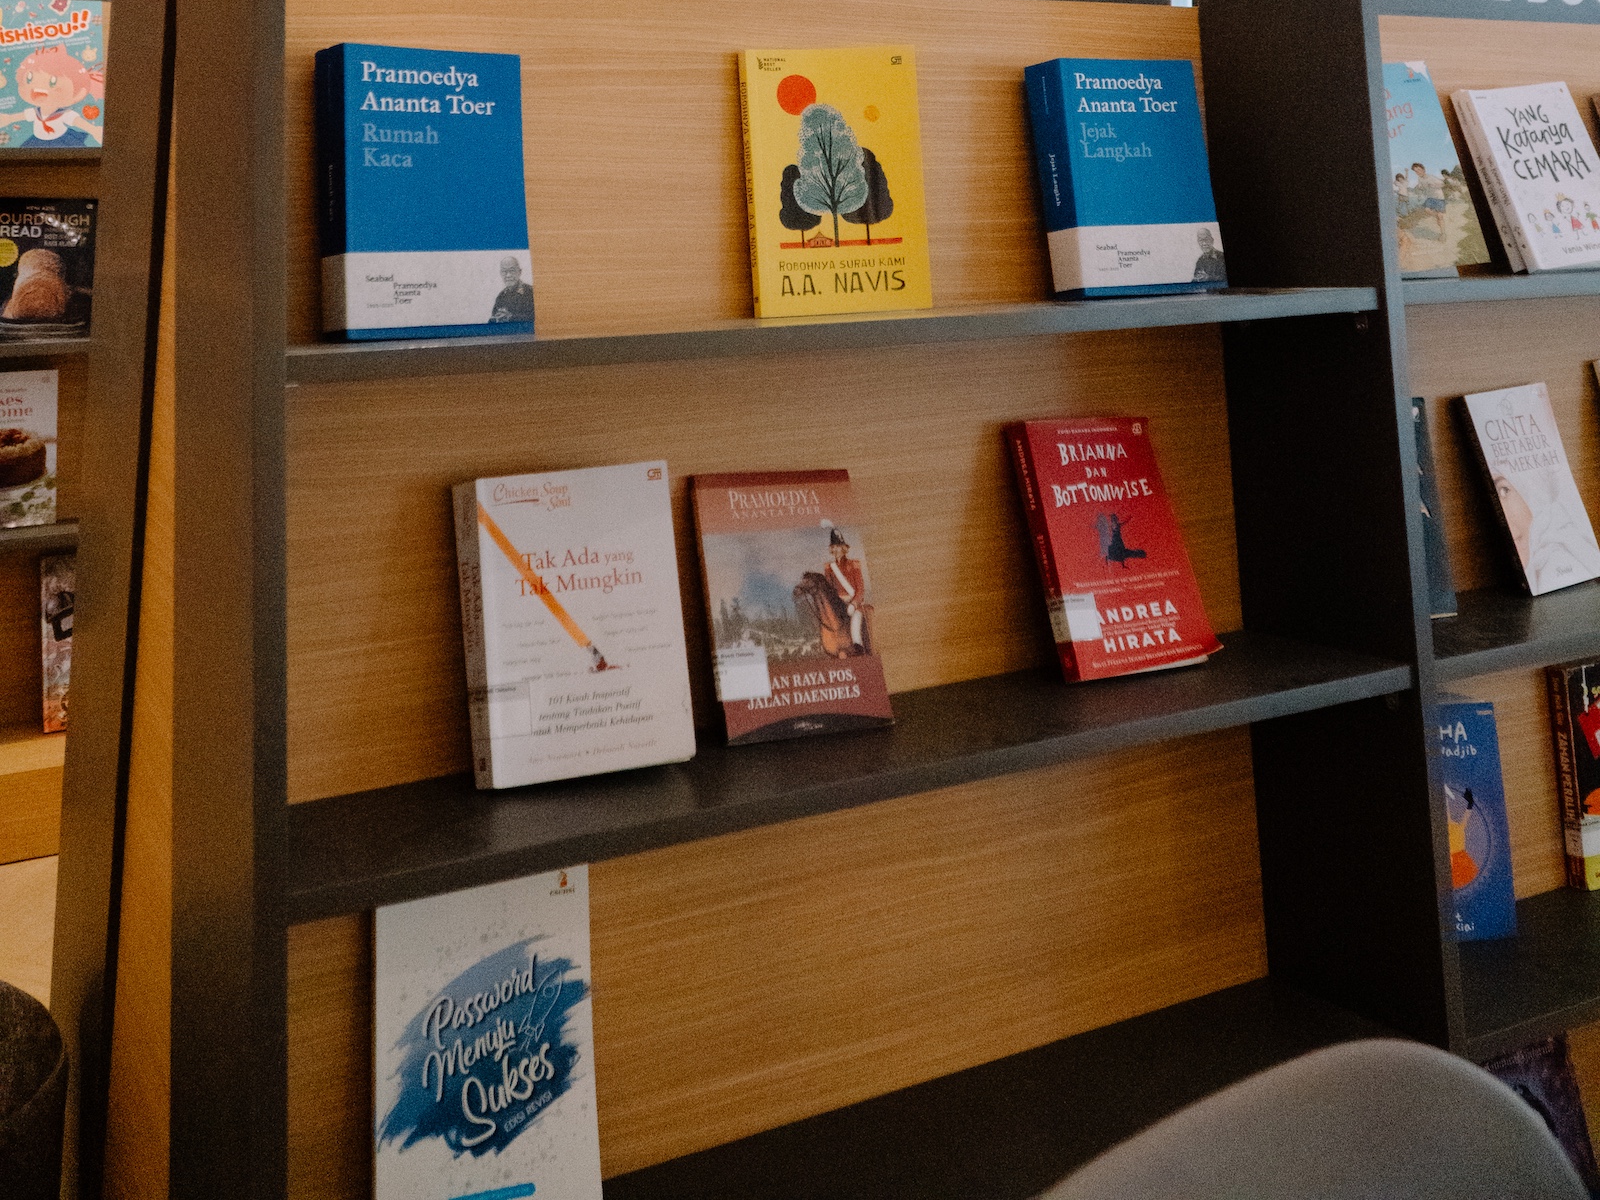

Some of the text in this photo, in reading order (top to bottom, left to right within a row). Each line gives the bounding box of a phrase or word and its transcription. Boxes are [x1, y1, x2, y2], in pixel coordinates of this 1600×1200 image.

[361, 61, 479, 92] Pramoedya
[1074, 72, 1163, 94] Pramoedya
[360, 92, 495, 116] Ananta Toer
[1077, 97, 1178, 113] Ananta Toer
[1505, 104, 1550, 128] YANG
[362, 123, 440, 144] Rumah
[1080, 122, 1117, 144] Jejak
[1496, 122, 1575, 159] Katanya
[362, 148, 414, 168] Kaca
[1083, 142, 1153, 162] Langkah
[1513, 148, 1592, 182] CEMARA
[779, 257, 906, 272] ROBOHNYA SURAU KAMI
[393, 282, 437, 291] Pramoedya
[781, 270, 906, 297] A.A. NAVIS
[1485, 414, 1541, 442] CINTA
[1057, 443, 1128, 466] BRIANNA
[1491, 435, 1551, 460] BERTABUR
[1085, 467, 1107, 479] DAN
[1509, 451, 1560, 474] MEKKAH
[492, 481, 568, 502] Chicken Soup
[728, 489, 820, 510] PRAMOEDYA
[731, 506, 821, 519] ANANTA TOER
[520, 547, 634, 571] Tak Ada yang
[515, 568, 643, 597] Tak Mungkin
[1103, 628, 1182, 654] HIRATA
[793, 672, 825, 687] RAYA
[747, 684, 861, 710] JALAN DAENDELS
[422, 953, 538, 1049] Password
[461, 1042, 555, 1147] Sukses
